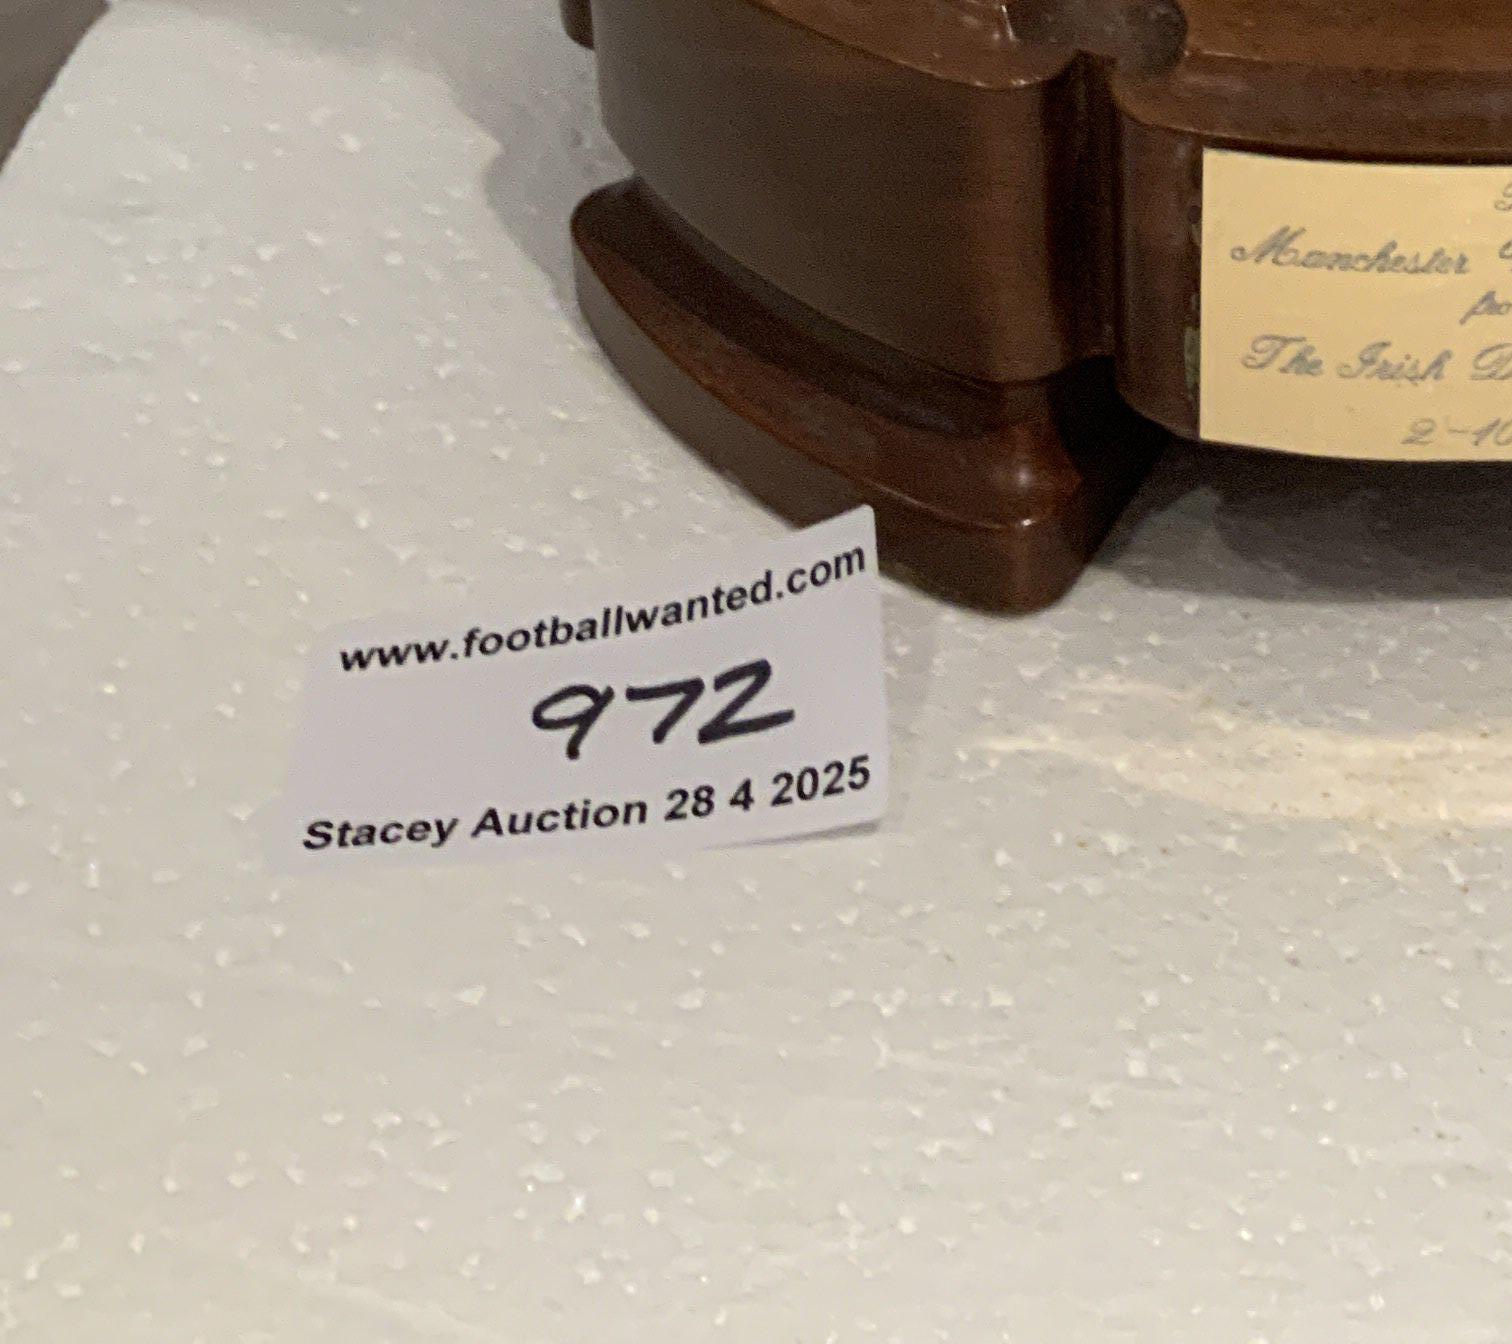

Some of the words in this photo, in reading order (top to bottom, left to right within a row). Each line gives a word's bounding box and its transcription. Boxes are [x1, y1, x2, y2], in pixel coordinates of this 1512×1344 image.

[1230, 225, 1469, 276] Manchester
[1241, 333, 1325, 377] The
[1339, 340, 1452, 386] Irish
[340, 545, 866, 673] www.footballwanted.com
[532, 659, 795, 761] 972
[302, 816, 459, 851] Stacey
[471, 798, 647, 839] Auction
[665, 786, 715, 821] 28
[729, 780, 755, 812] 4
[772, 754, 871, 808] 2025
